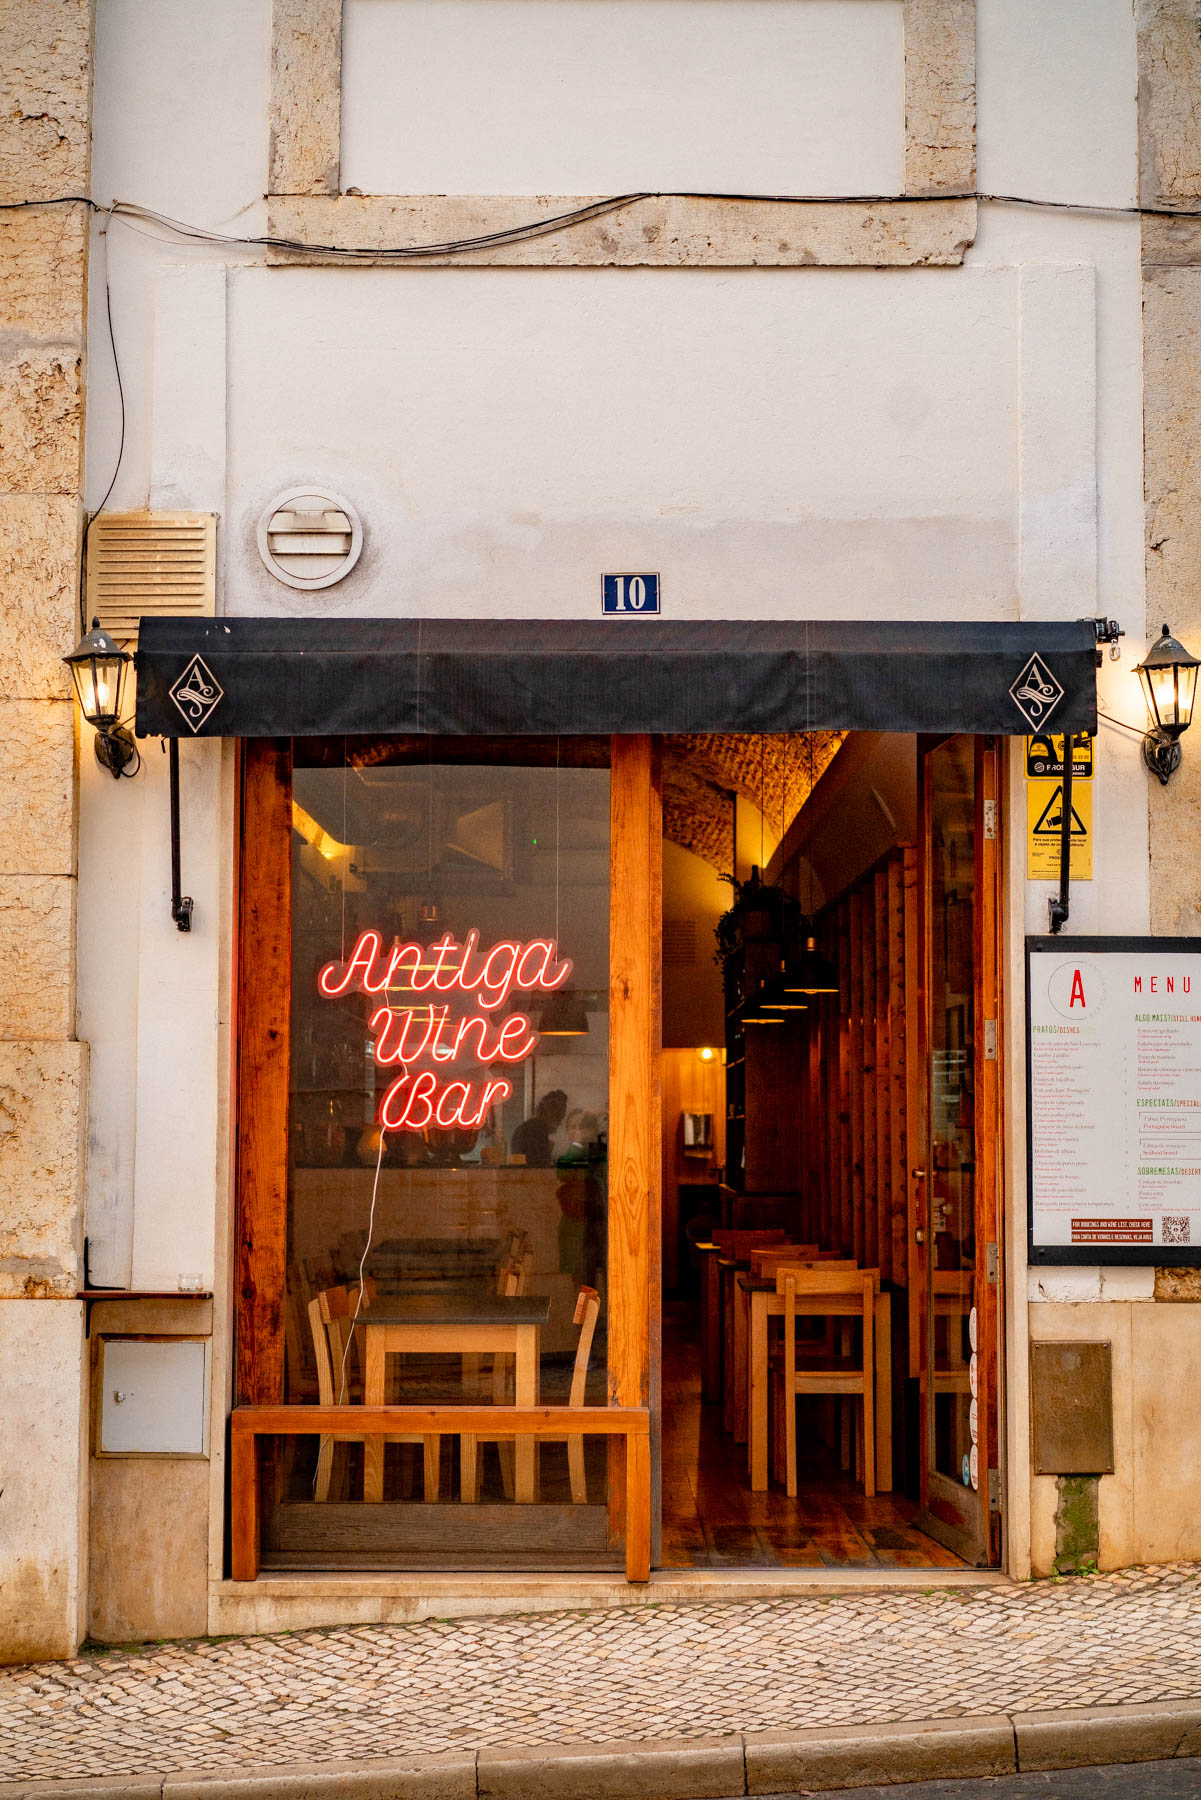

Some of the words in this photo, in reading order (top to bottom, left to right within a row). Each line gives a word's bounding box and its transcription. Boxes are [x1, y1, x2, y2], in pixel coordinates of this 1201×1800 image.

[614, 576, 646, 611] 10
[321, 932, 569, 1009] Antiga
[1069, 969, 1086, 1008] A
[1134, 976, 1191, 993] MENU
[370, 1003, 535, 1063] Wine
[1135, 1013, 1151, 1022] ALGO
[382, 1071, 509, 1128] Bar
